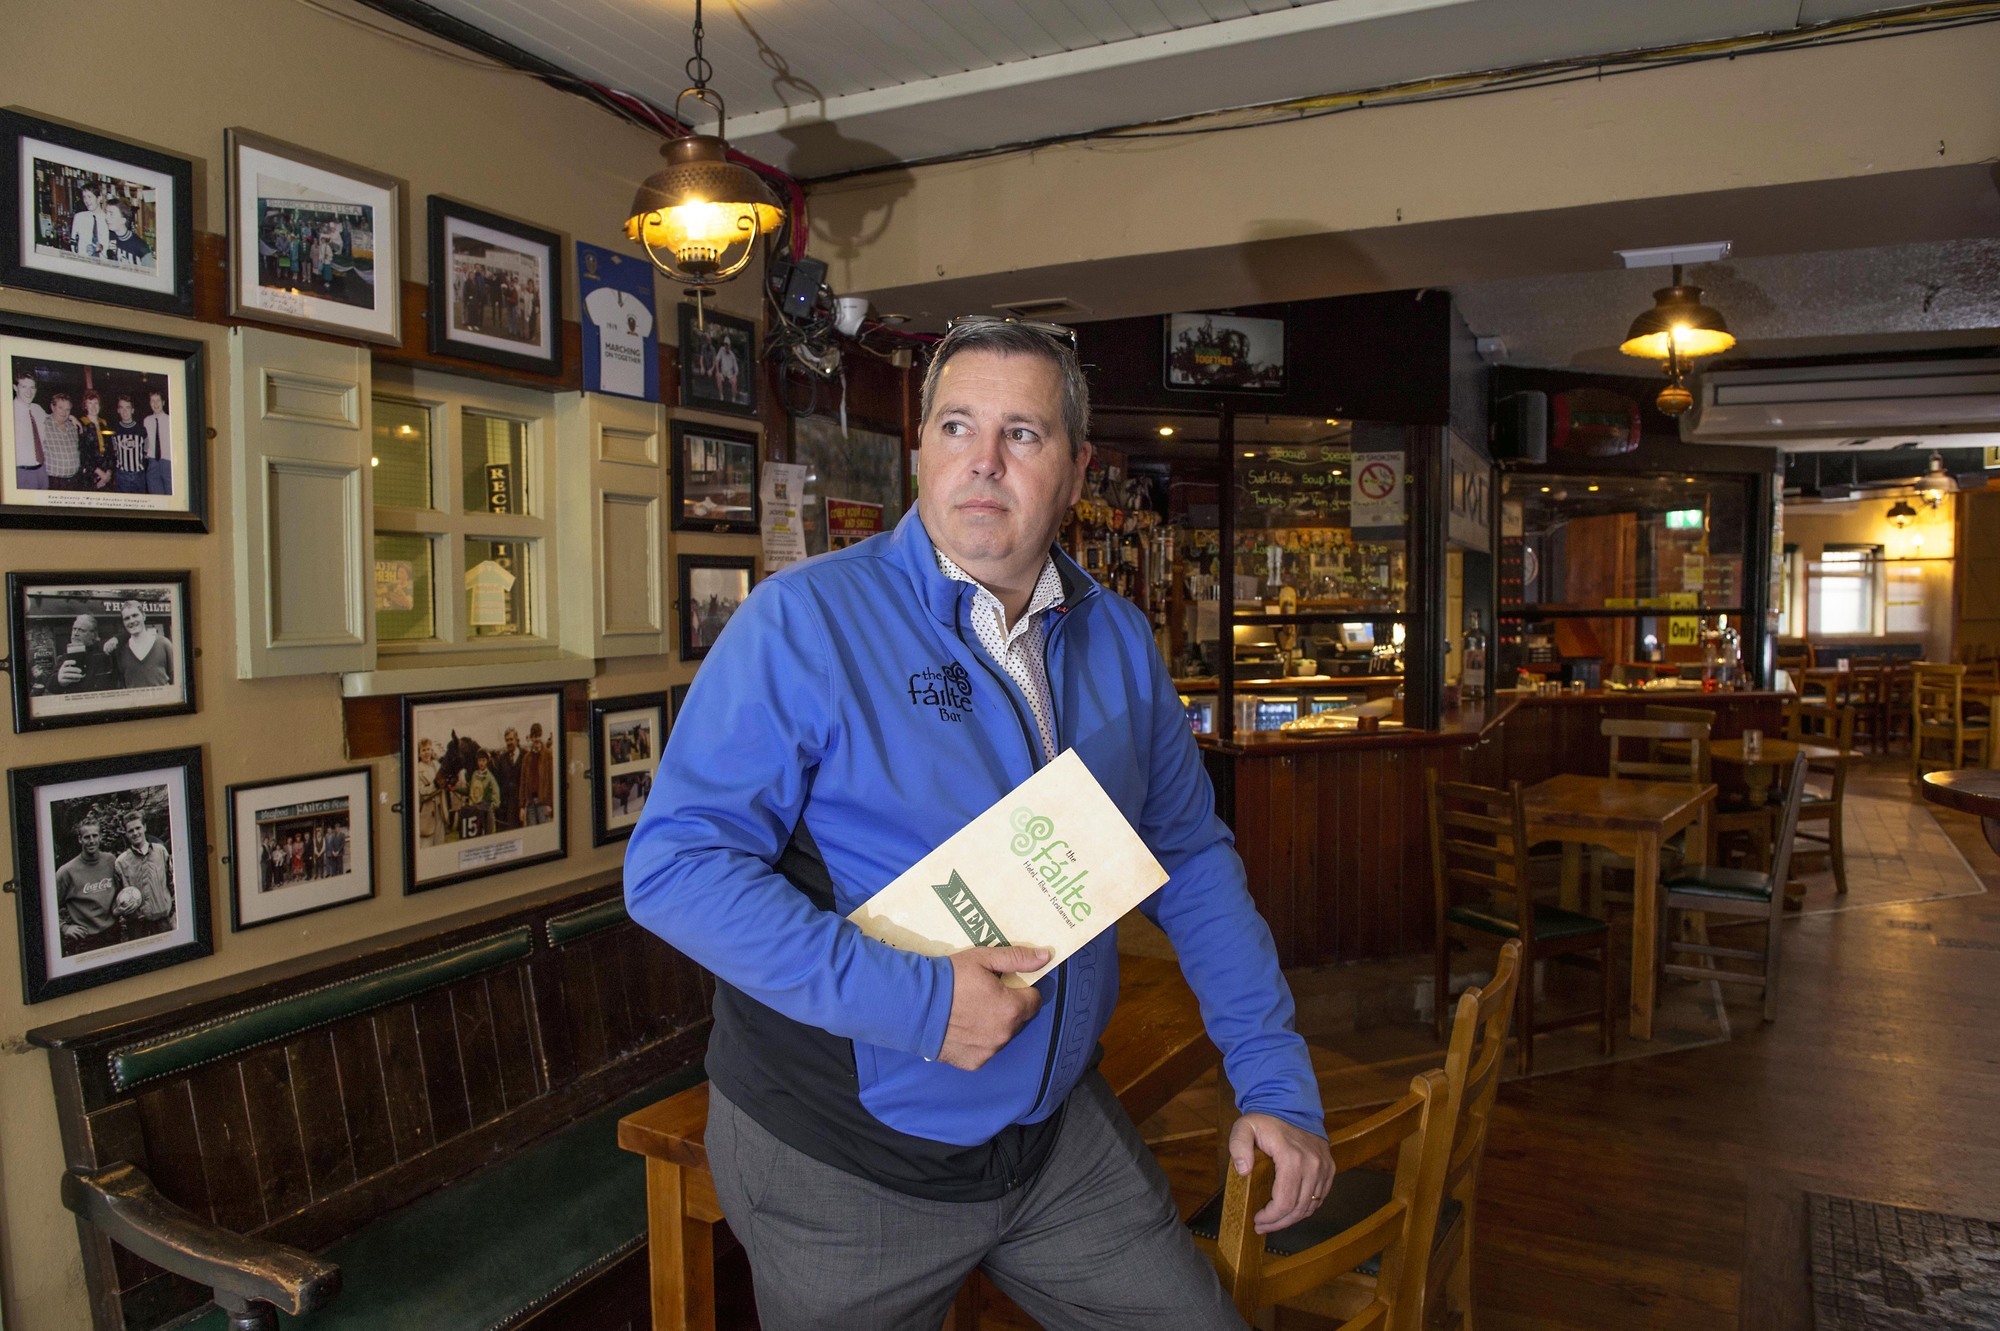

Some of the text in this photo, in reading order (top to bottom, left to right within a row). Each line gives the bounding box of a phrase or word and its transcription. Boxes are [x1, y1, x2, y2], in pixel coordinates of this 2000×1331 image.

[605, 342, 641, 357] MARCHING
[605, 351, 641, 364] ON TOGETHER
[142, 601, 170, 612] ÁILTE
[1672, 621, 1696, 642] Only
[923, 666, 943, 680] the
[938, 708, 962, 722] Bar
[462, 816, 477, 838] 15
[1065, 849, 1077, 863] the
[83, 877, 113, 894] Coca-Cola
[1030, 840, 1092, 922] fáilte
[1023, 860, 1076, 929] Hotel Bar Restaurant
